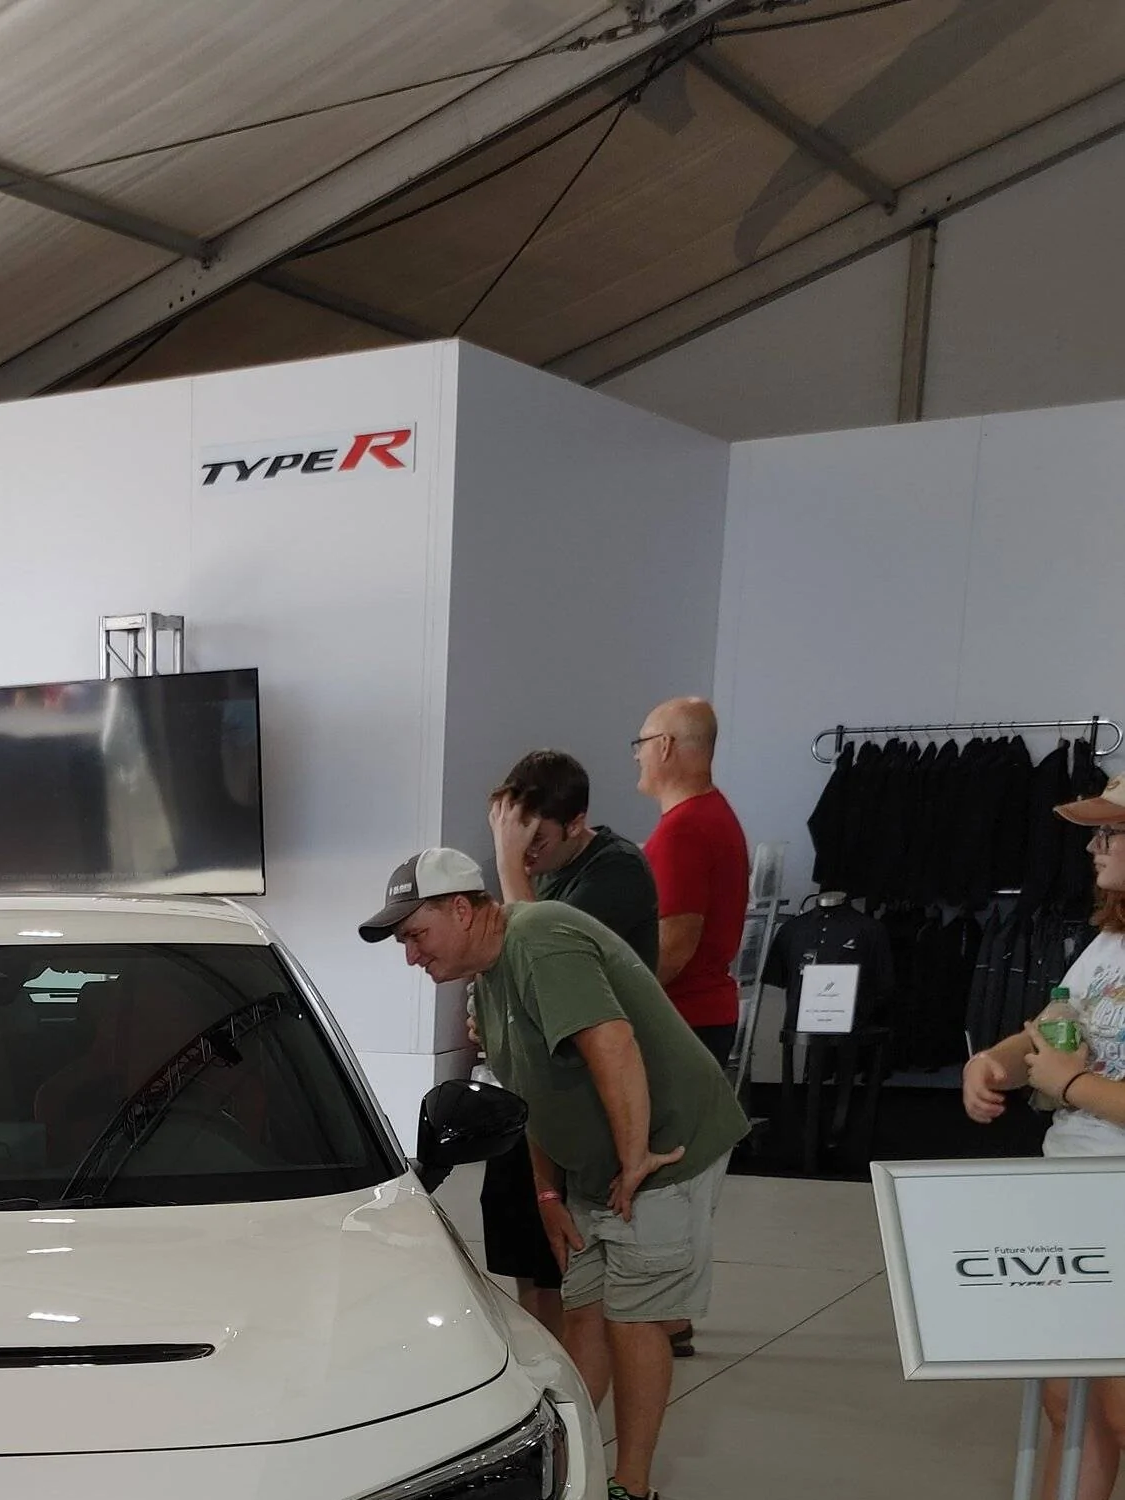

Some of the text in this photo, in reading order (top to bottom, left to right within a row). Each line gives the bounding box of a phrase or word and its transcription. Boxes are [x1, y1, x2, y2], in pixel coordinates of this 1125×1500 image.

[201, 429, 412, 486] TYPE R
[994, 1245, 1064, 1255] Future Vehicle
[955, 1254, 1110, 1278] CIVIC
[1046, 1279, 1063, 1287] R
